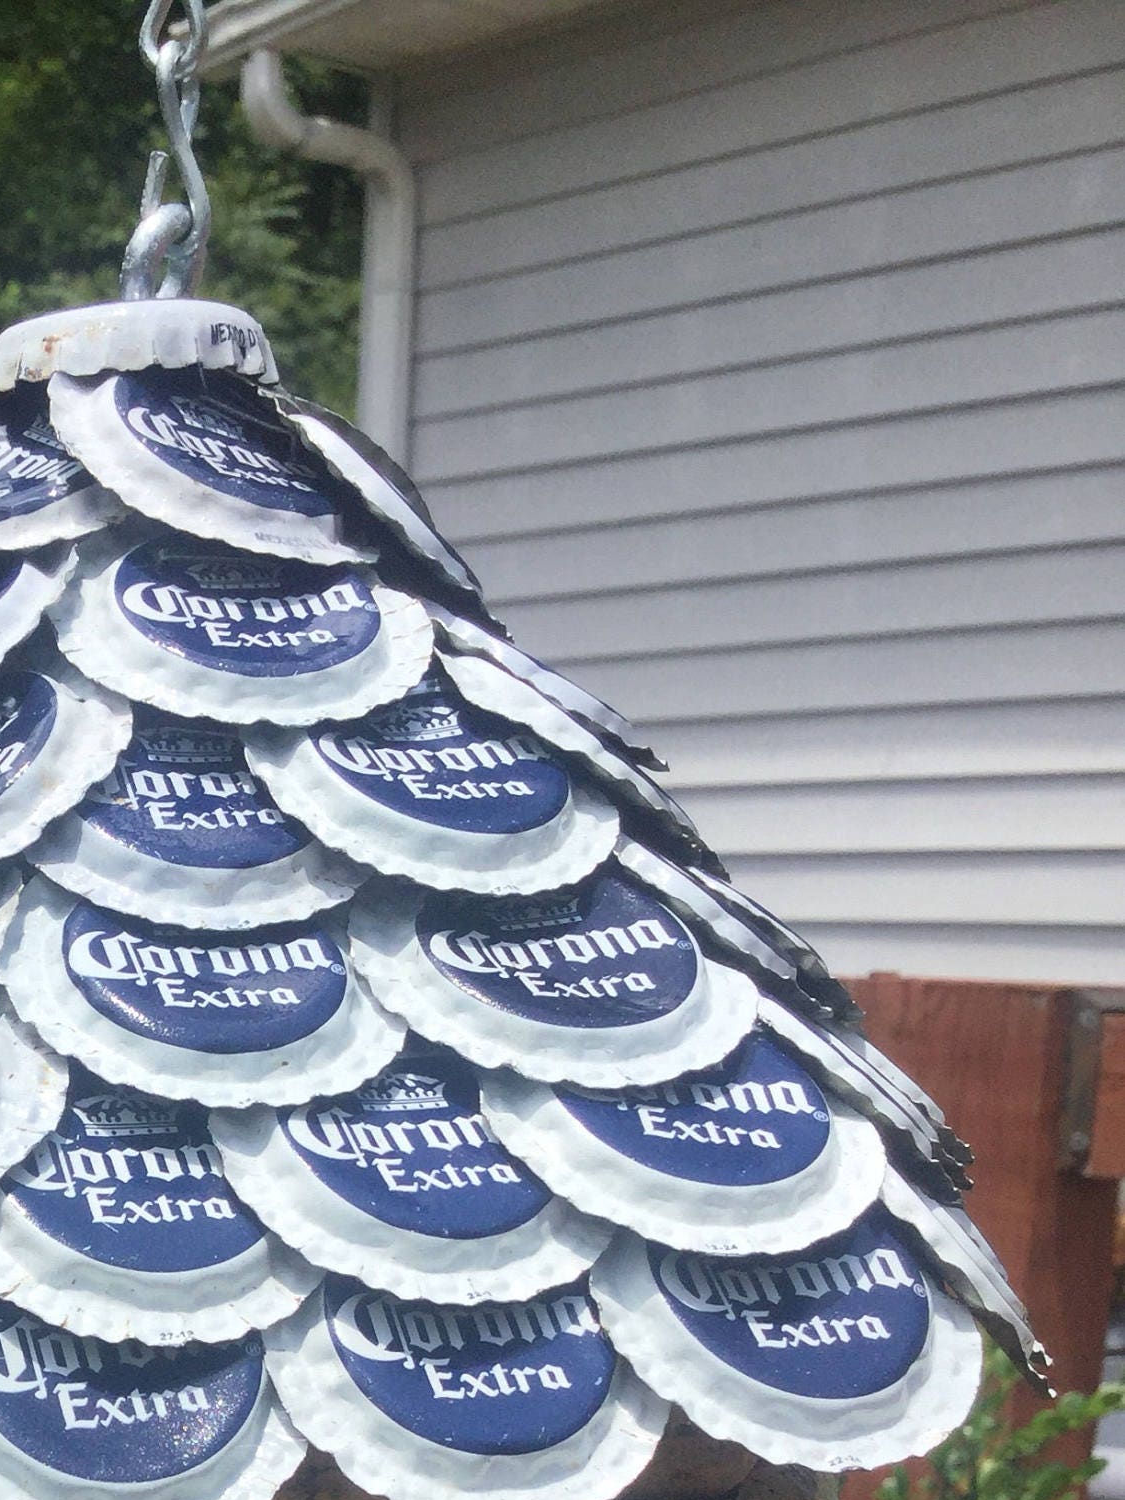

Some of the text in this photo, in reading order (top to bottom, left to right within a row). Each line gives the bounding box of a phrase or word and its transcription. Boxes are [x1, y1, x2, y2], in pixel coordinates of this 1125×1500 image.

[127, 406, 316, 479] Corona
[205, 455, 317, 493] Extra
[123, 582, 367, 628] Corona
[201, 621, 338, 648] Extra
[397, 773, 535, 800] Extra
[145, 800, 285, 830] Extra
[68, 931, 333, 986] Corona
[429, 919, 678, 979] Corona
[153, 976, 301, 1009] Extra
[515, 968, 657, 999] Extra
[288, 1106, 500, 1168] Coron
[626, 1102, 782, 1149] Extra
[372, 1157, 521, 1193] Extra
[82, 1186, 237, 1224] Extra
[660, 1248, 914, 1320] Corona
[334, 1294, 603, 1370] Corona
[741, 1309, 892, 1349] Extra
[420, 1357, 572, 1399] Extra
[53, 1381, 210, 1430] Extra
